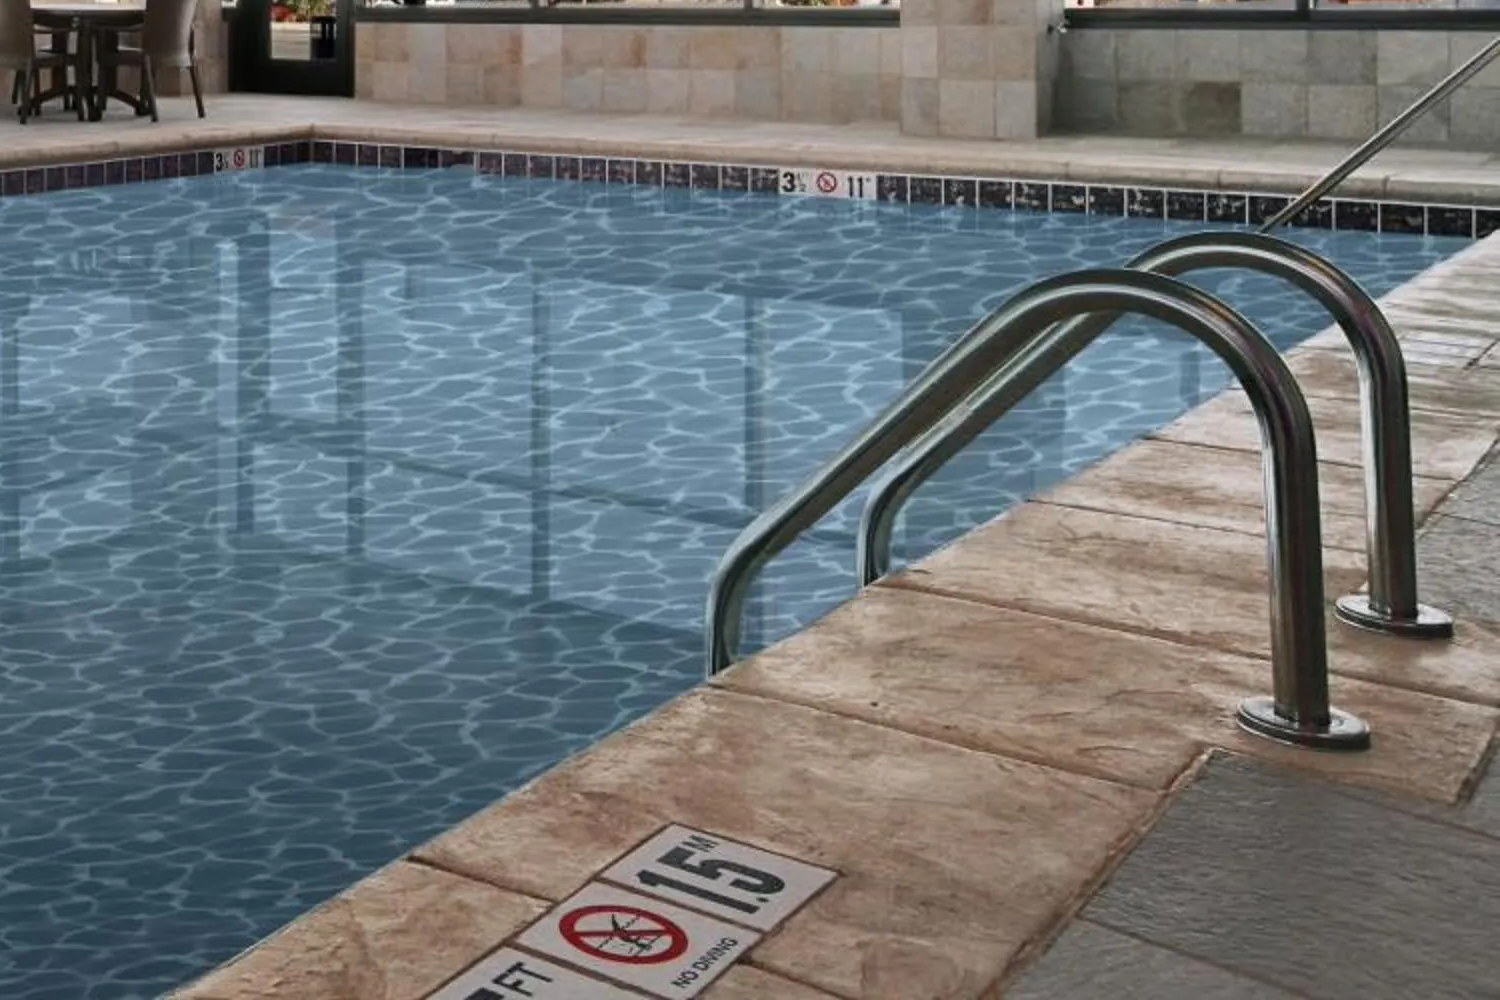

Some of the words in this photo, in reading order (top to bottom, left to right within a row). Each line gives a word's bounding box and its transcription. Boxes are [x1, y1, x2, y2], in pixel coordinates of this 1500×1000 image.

[782, 172, 796, 193] 3
[491, 961, 554, 997] FT
[670, 970, 699, 989] NO
[692, 937, 739, 971] DIVING
